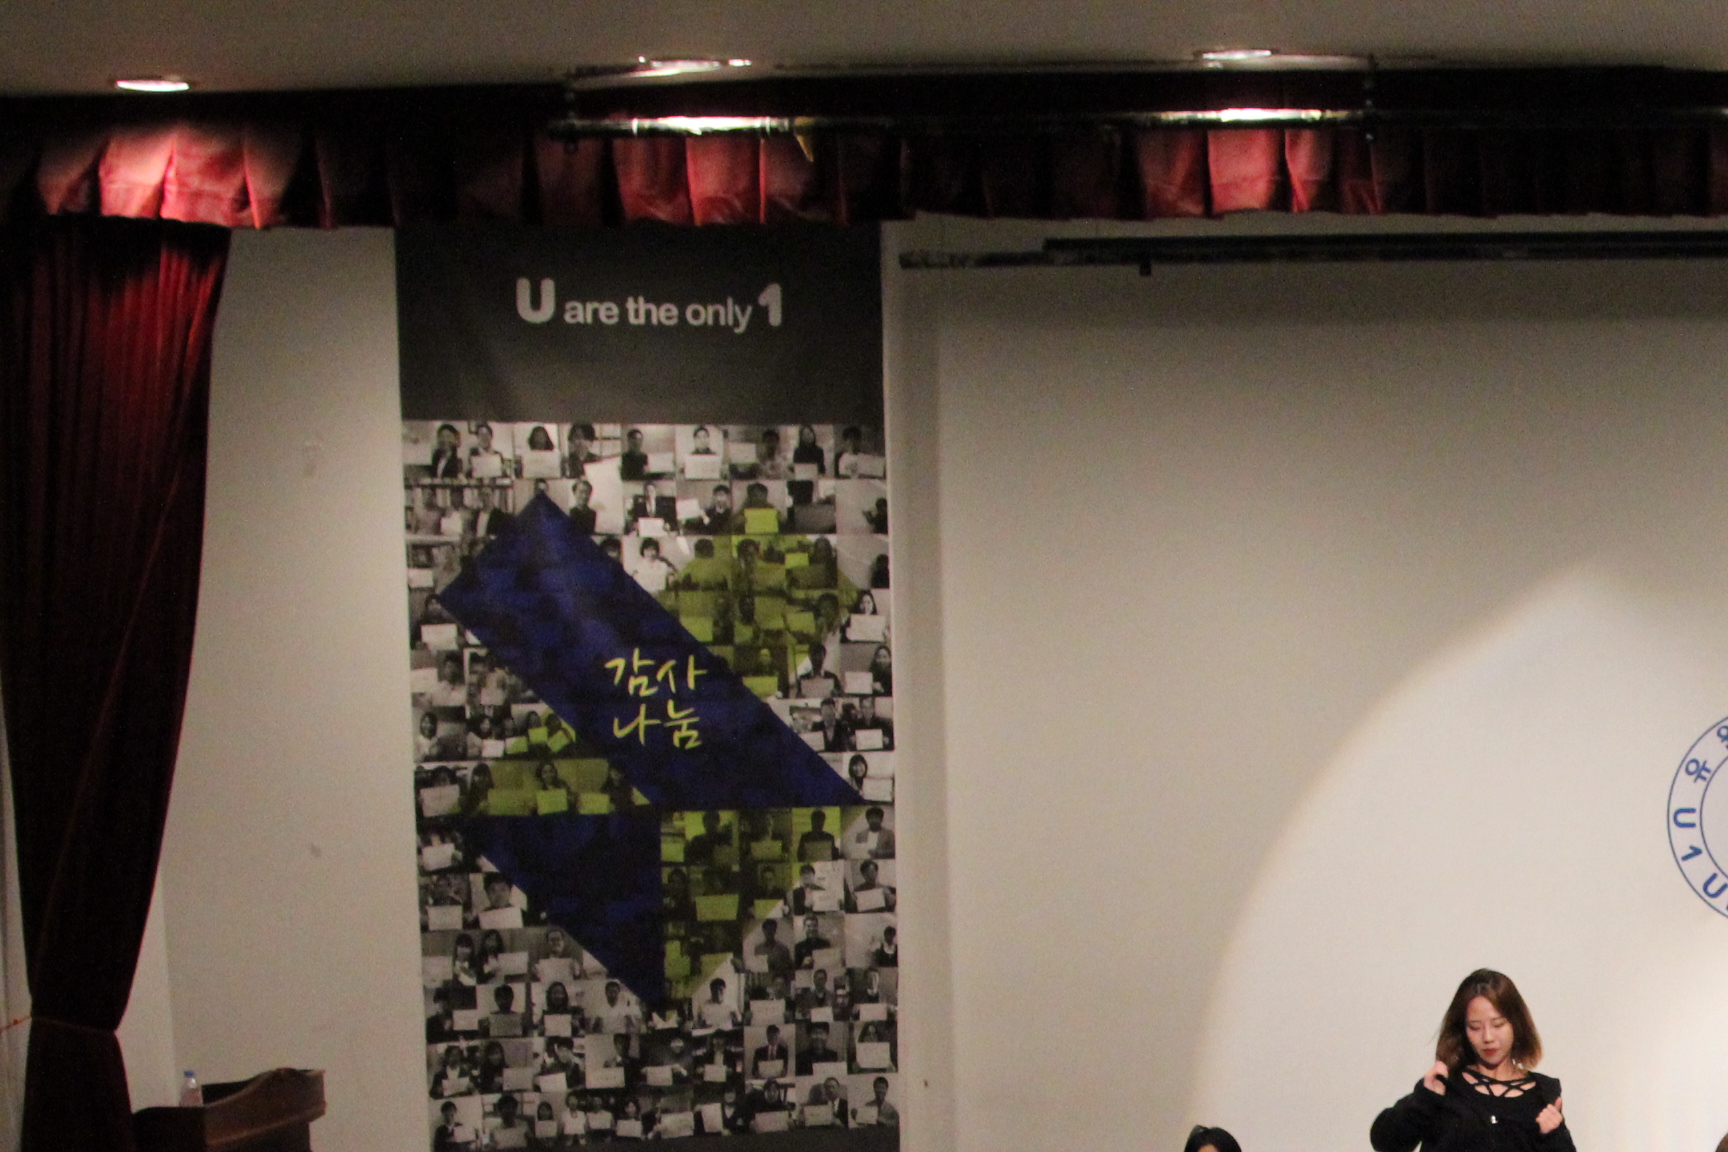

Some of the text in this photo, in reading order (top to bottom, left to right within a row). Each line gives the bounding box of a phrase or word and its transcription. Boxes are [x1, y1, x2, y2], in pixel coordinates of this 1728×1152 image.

[515, 277, 782, 334] U are the only 1
[604, 647, 708, 697] 감사
[613, 699, 702, 750] 나눔
